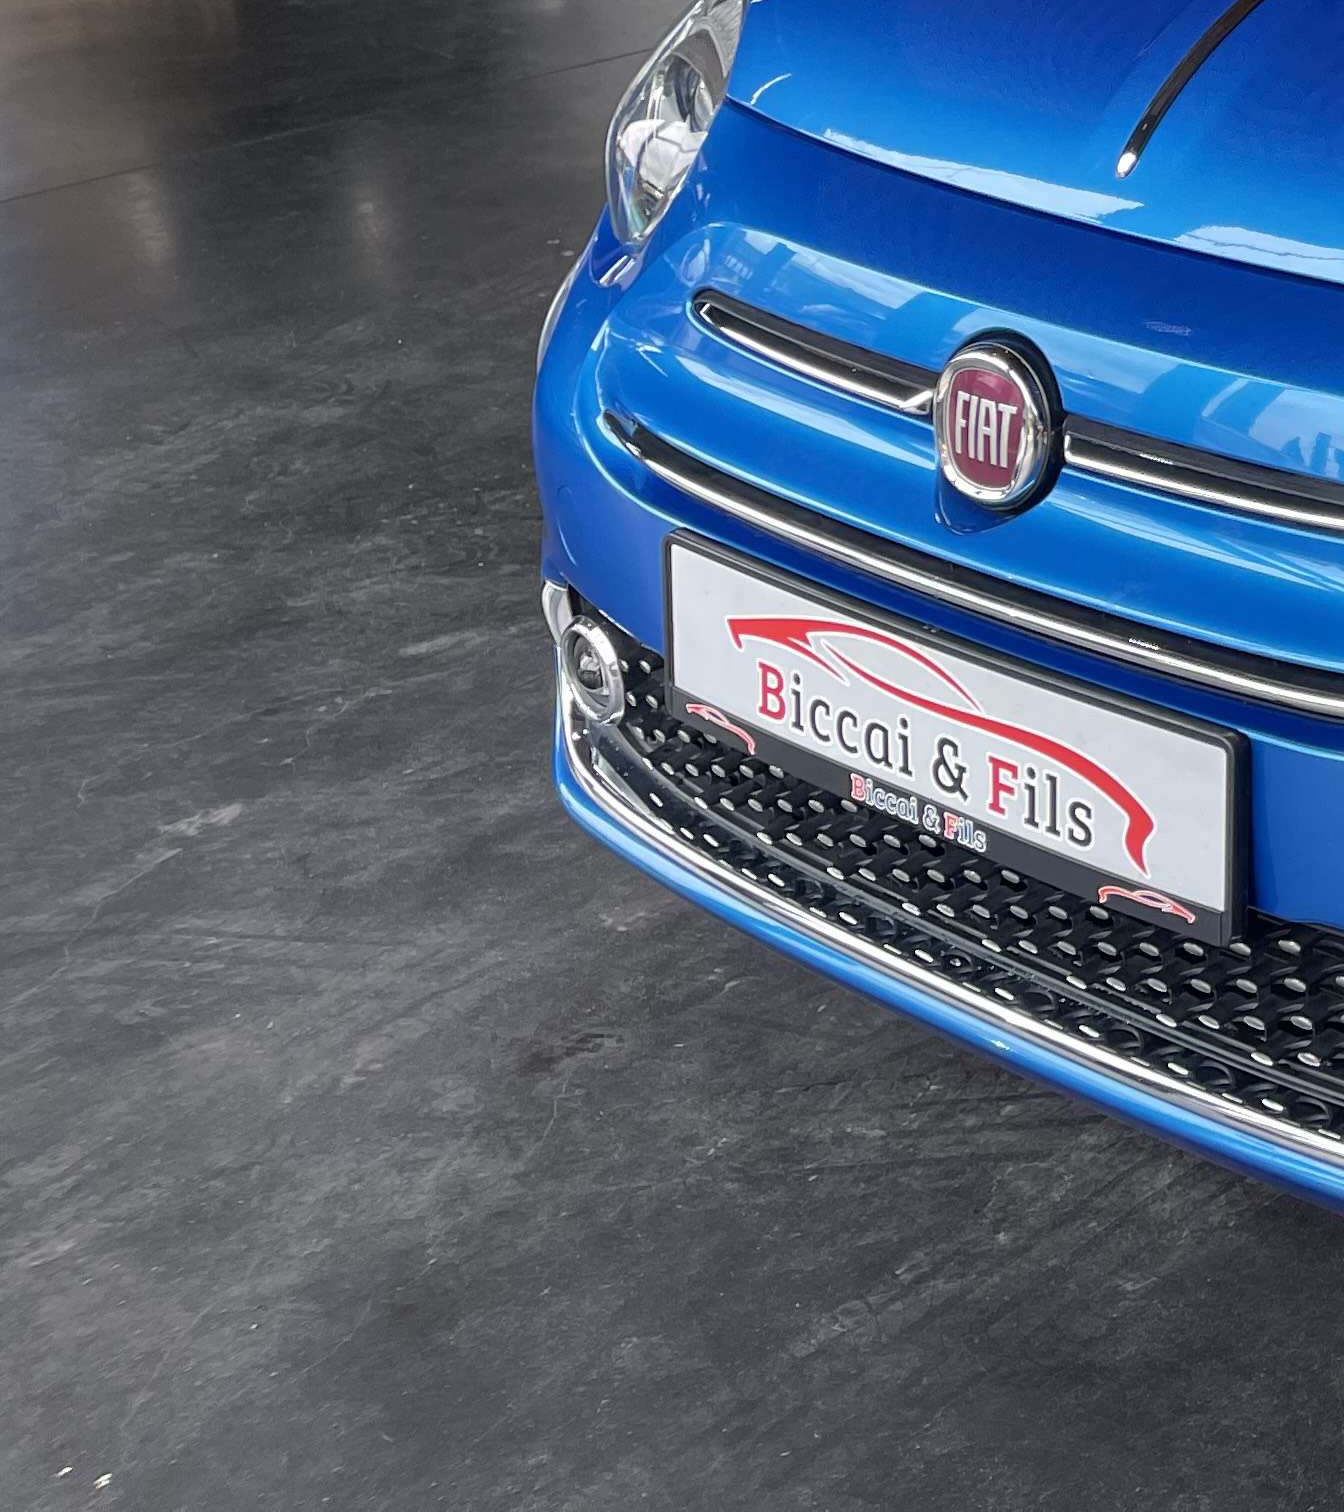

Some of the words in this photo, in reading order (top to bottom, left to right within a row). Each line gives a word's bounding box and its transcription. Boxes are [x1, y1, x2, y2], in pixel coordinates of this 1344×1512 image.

[955, 390, 1018, 469] FIAT
[758, 661, 913, 777] Biccai
[932, 738, 969, 801] &
[987, 754, 1094, 847] Fils
[850, 773, 919, 825] Biccai
[922, 804, 941, 834] &
[944, 811, 987, 853] Fils
